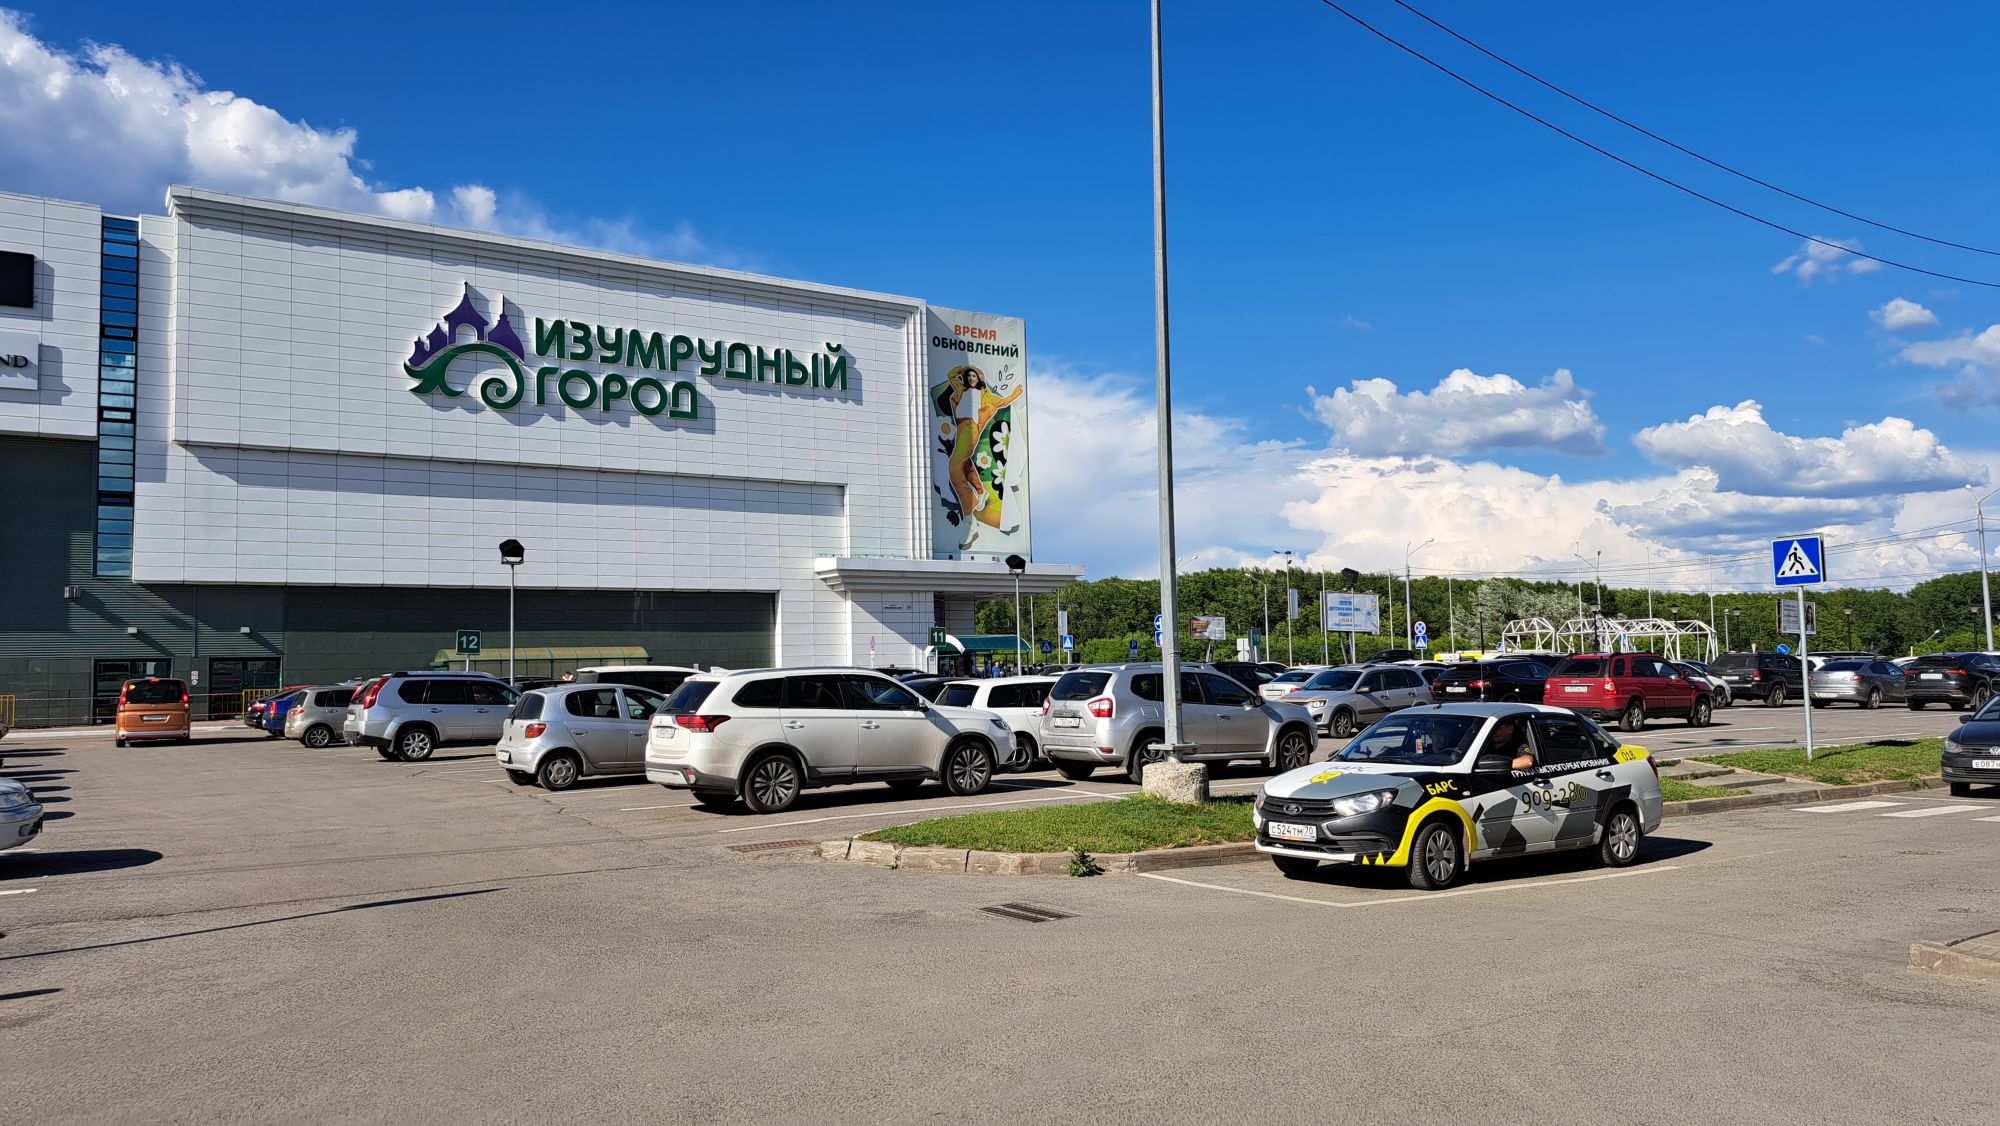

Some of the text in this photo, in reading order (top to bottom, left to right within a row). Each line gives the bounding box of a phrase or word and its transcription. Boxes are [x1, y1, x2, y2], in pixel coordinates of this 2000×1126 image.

[953, 324, 997, 341] ВРЕМЯ
[535, 317, 848, 391] ИЗУМРУДНЫЙ
[932, 335, 1019, 358] ОБНОВЛЕНИЙ
[535, 366, 699, 420] ГОРОД
[460, 635, 479, 649] 12
[932, 631, 944, 643] 11
[1425, 779, 1458, 796] БАРС
[1521, 781, 1588, 814] 909-280
